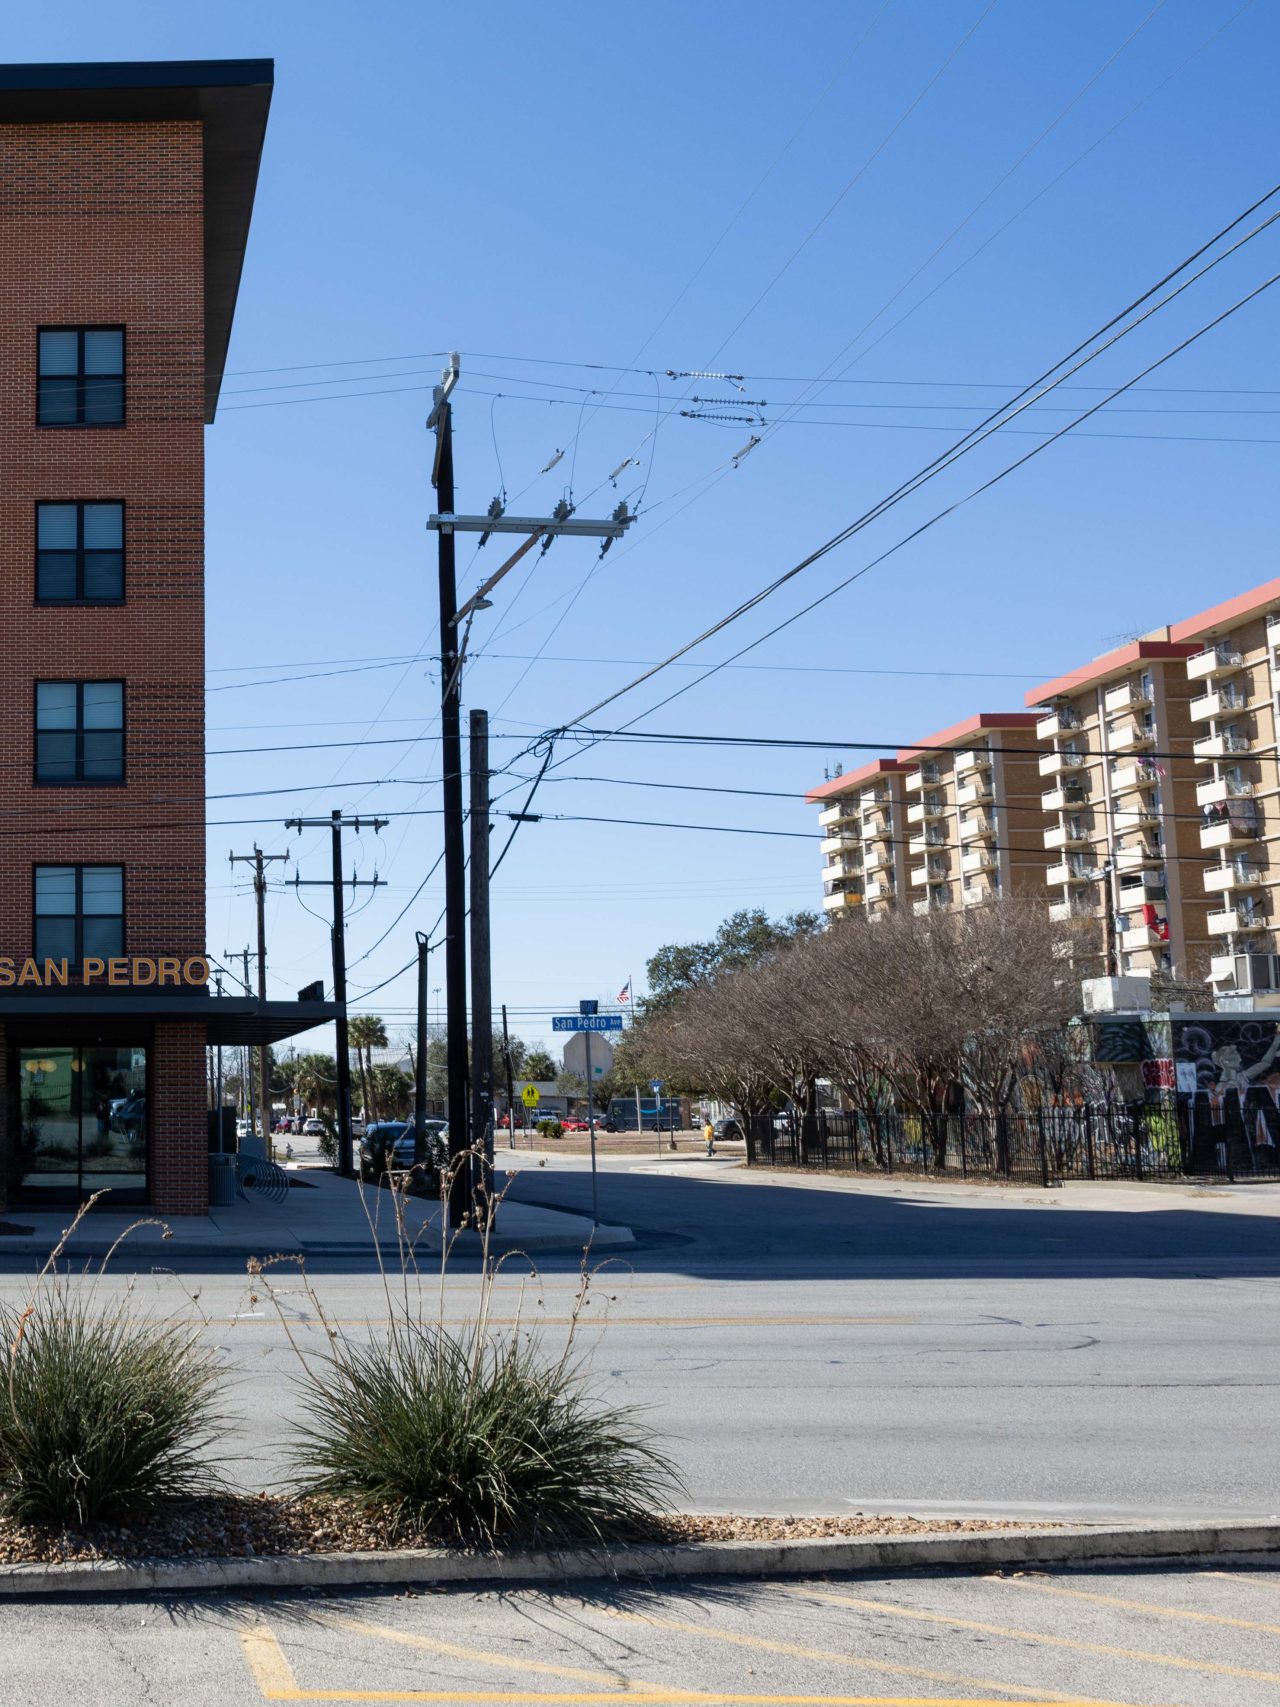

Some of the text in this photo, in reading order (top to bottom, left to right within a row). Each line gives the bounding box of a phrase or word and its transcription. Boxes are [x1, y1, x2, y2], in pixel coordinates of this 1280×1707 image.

[83, 956, 211, 986] PEDRO
[554, 1018, 573, 1029] San
[577, 1016, 607, 1029] Pedro
